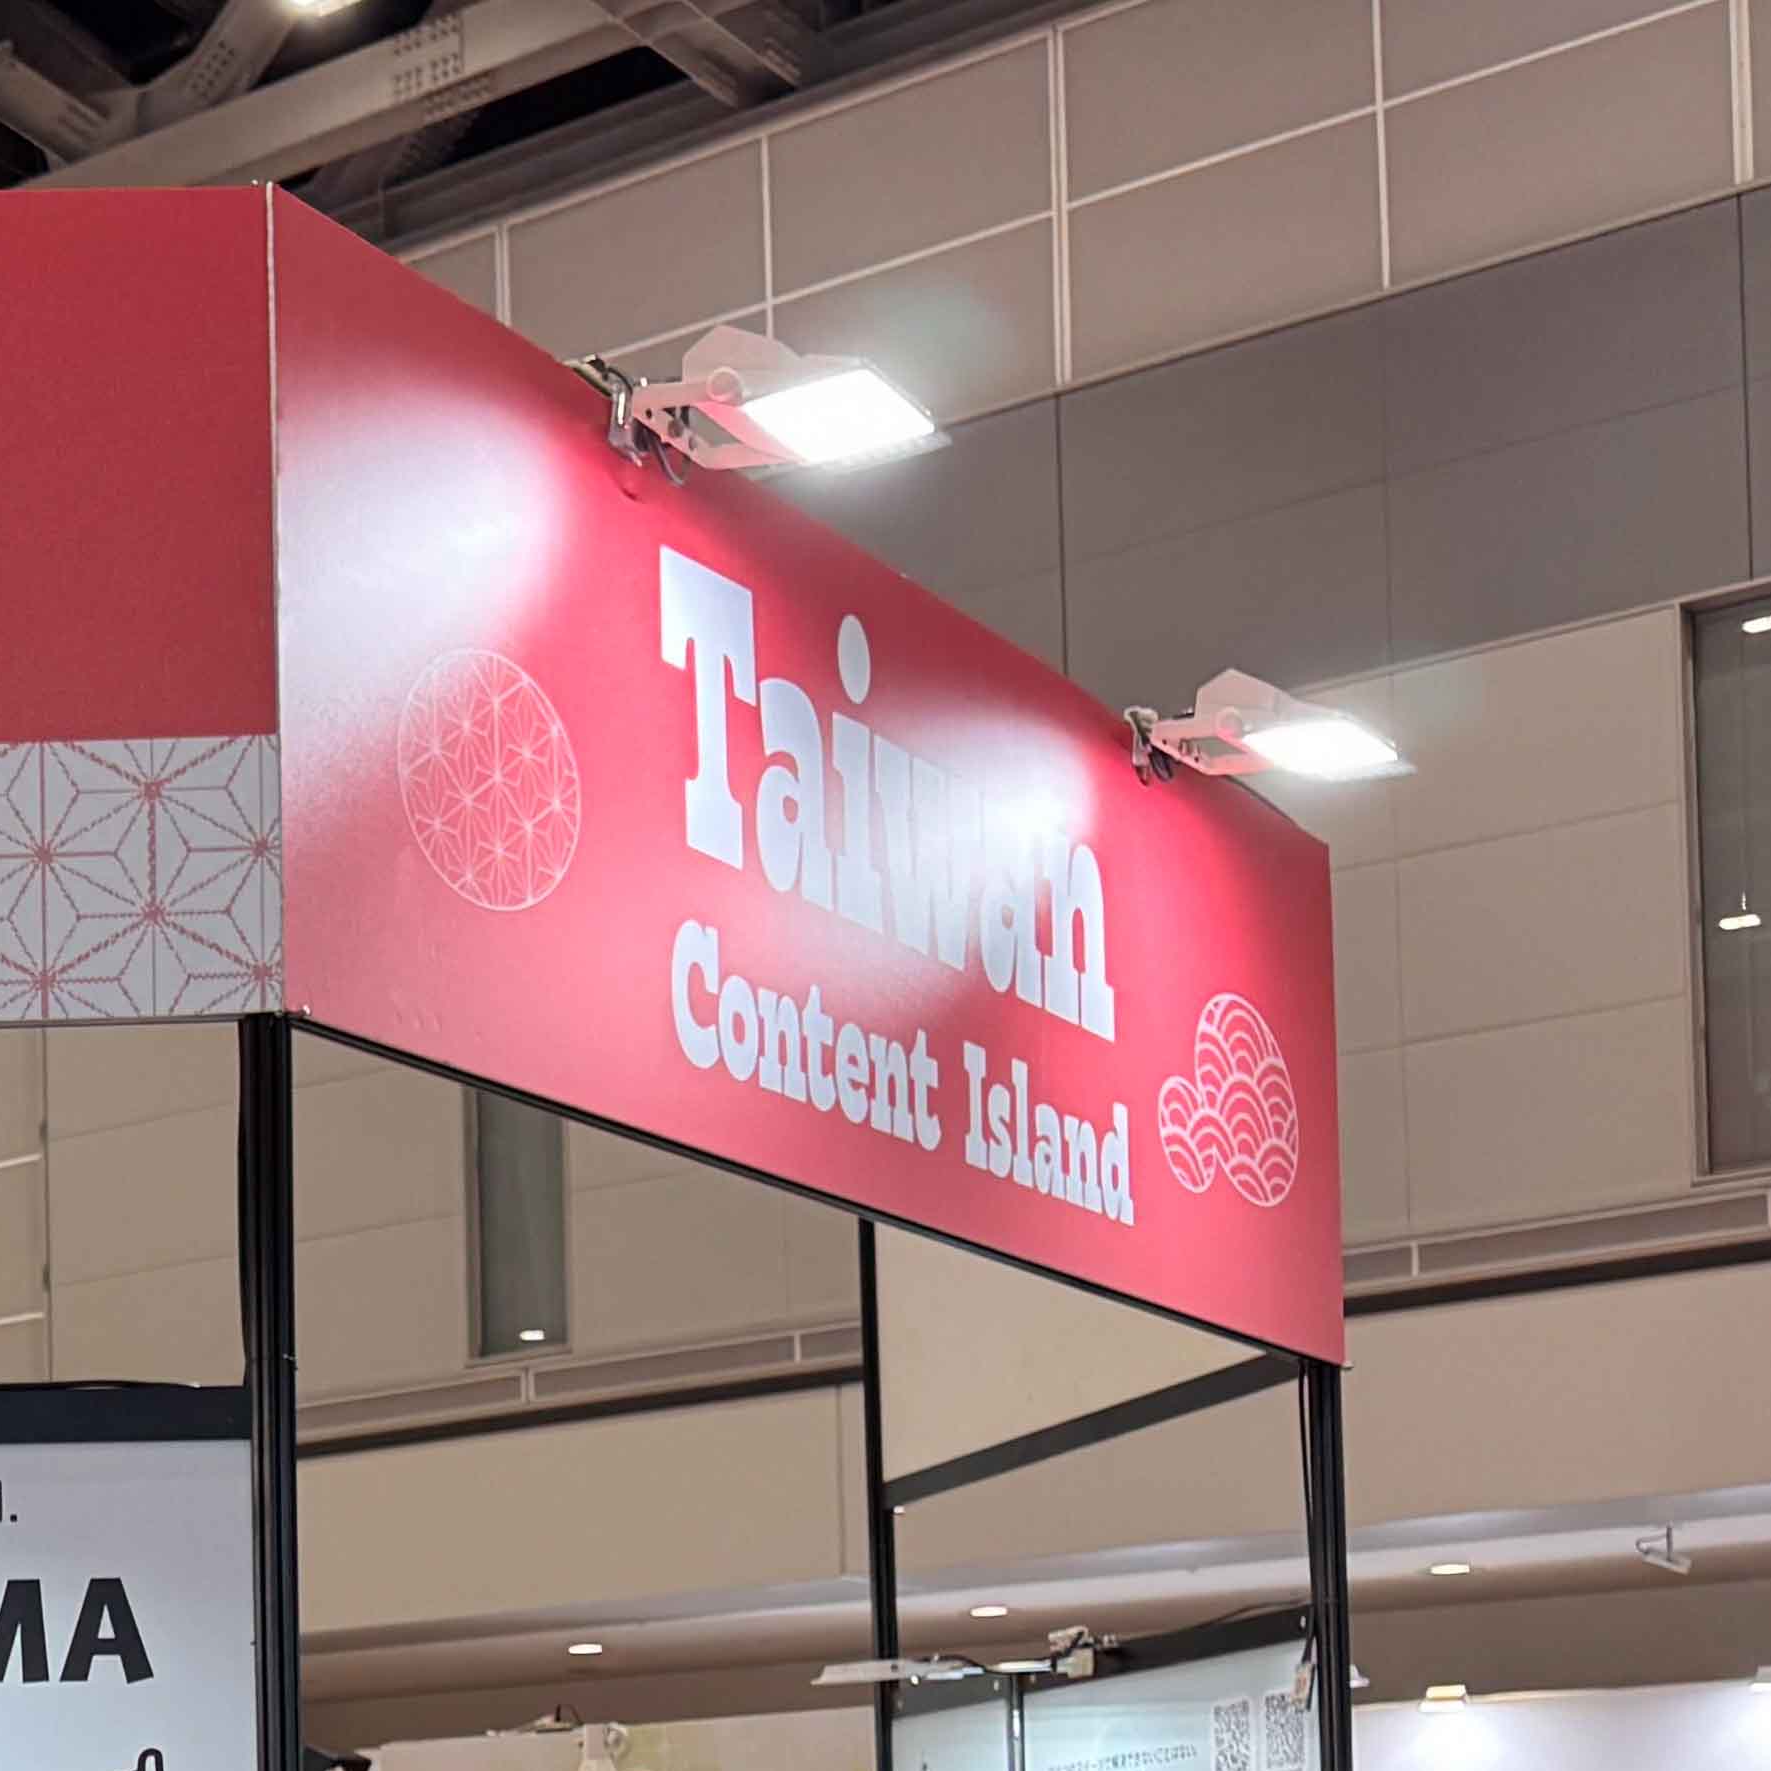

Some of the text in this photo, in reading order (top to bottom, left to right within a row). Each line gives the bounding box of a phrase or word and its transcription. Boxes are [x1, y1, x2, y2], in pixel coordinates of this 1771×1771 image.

[659, 544, 1115, 1042] Taiwan
[671, 918, 1135, 1226] Content Island
